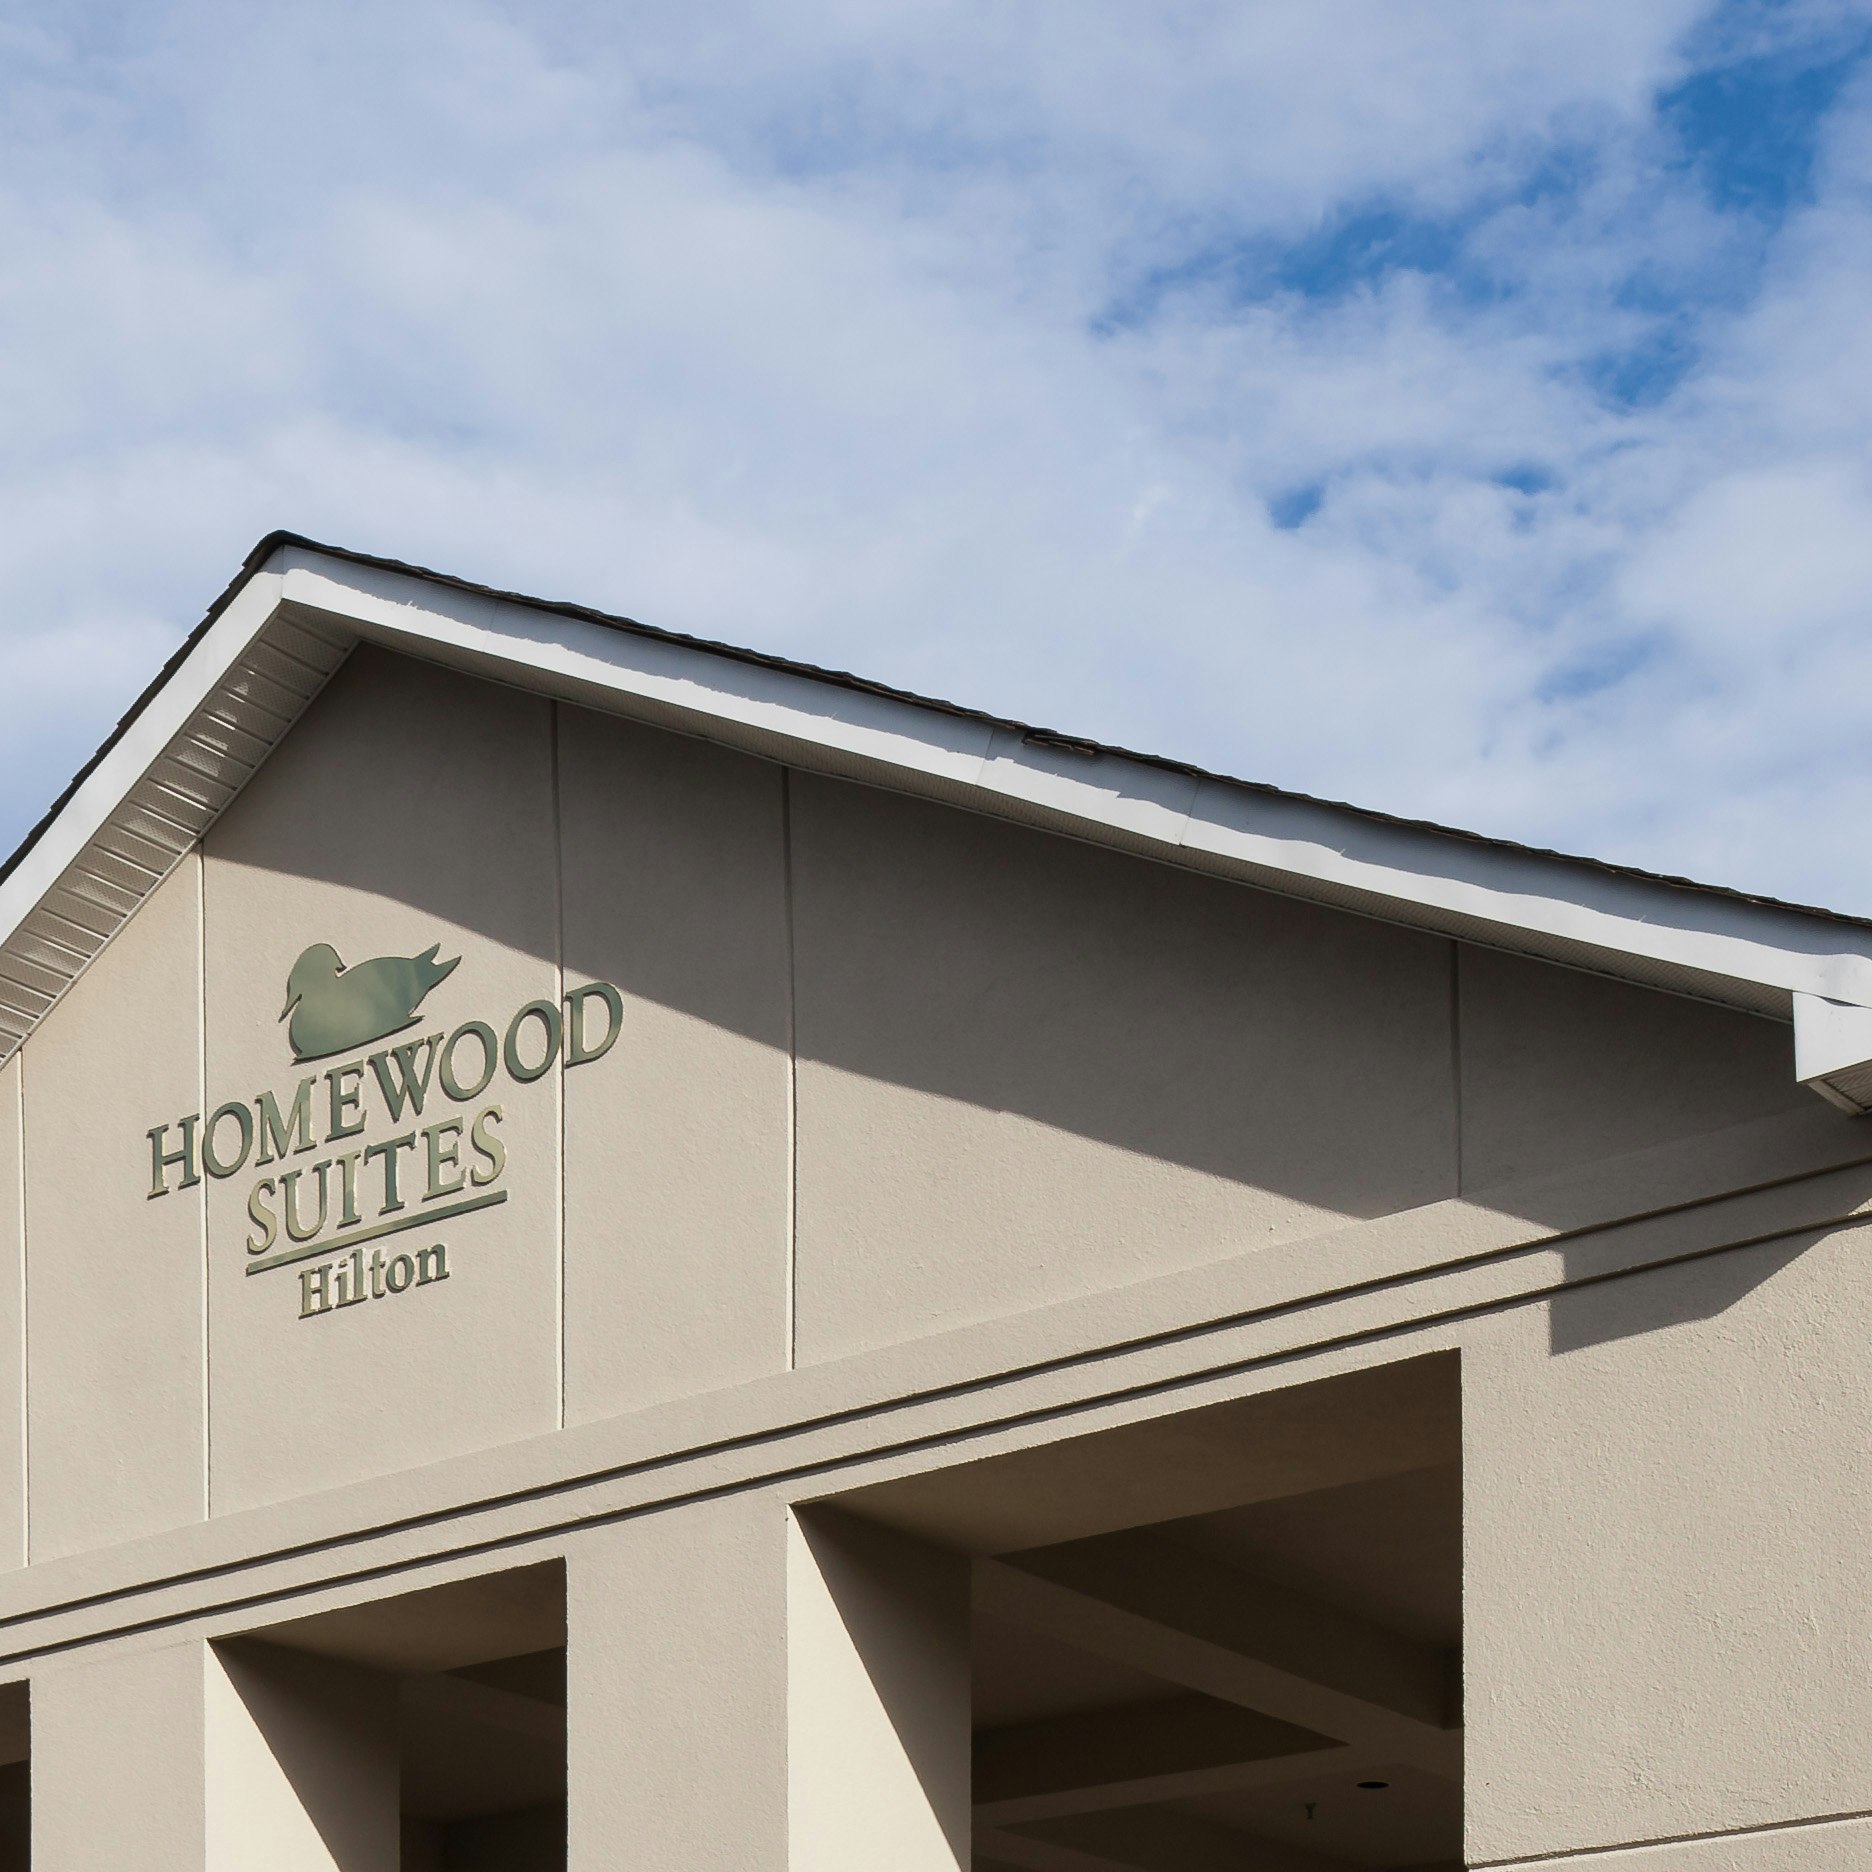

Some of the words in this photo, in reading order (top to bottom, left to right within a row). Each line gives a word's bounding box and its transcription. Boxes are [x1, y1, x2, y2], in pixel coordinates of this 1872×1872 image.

[146, 982, 624, 1201] HOMEWOOD
[246, 1104, 508, 1256] SUITES
[298, 1243, 451, 1320] Hilton
